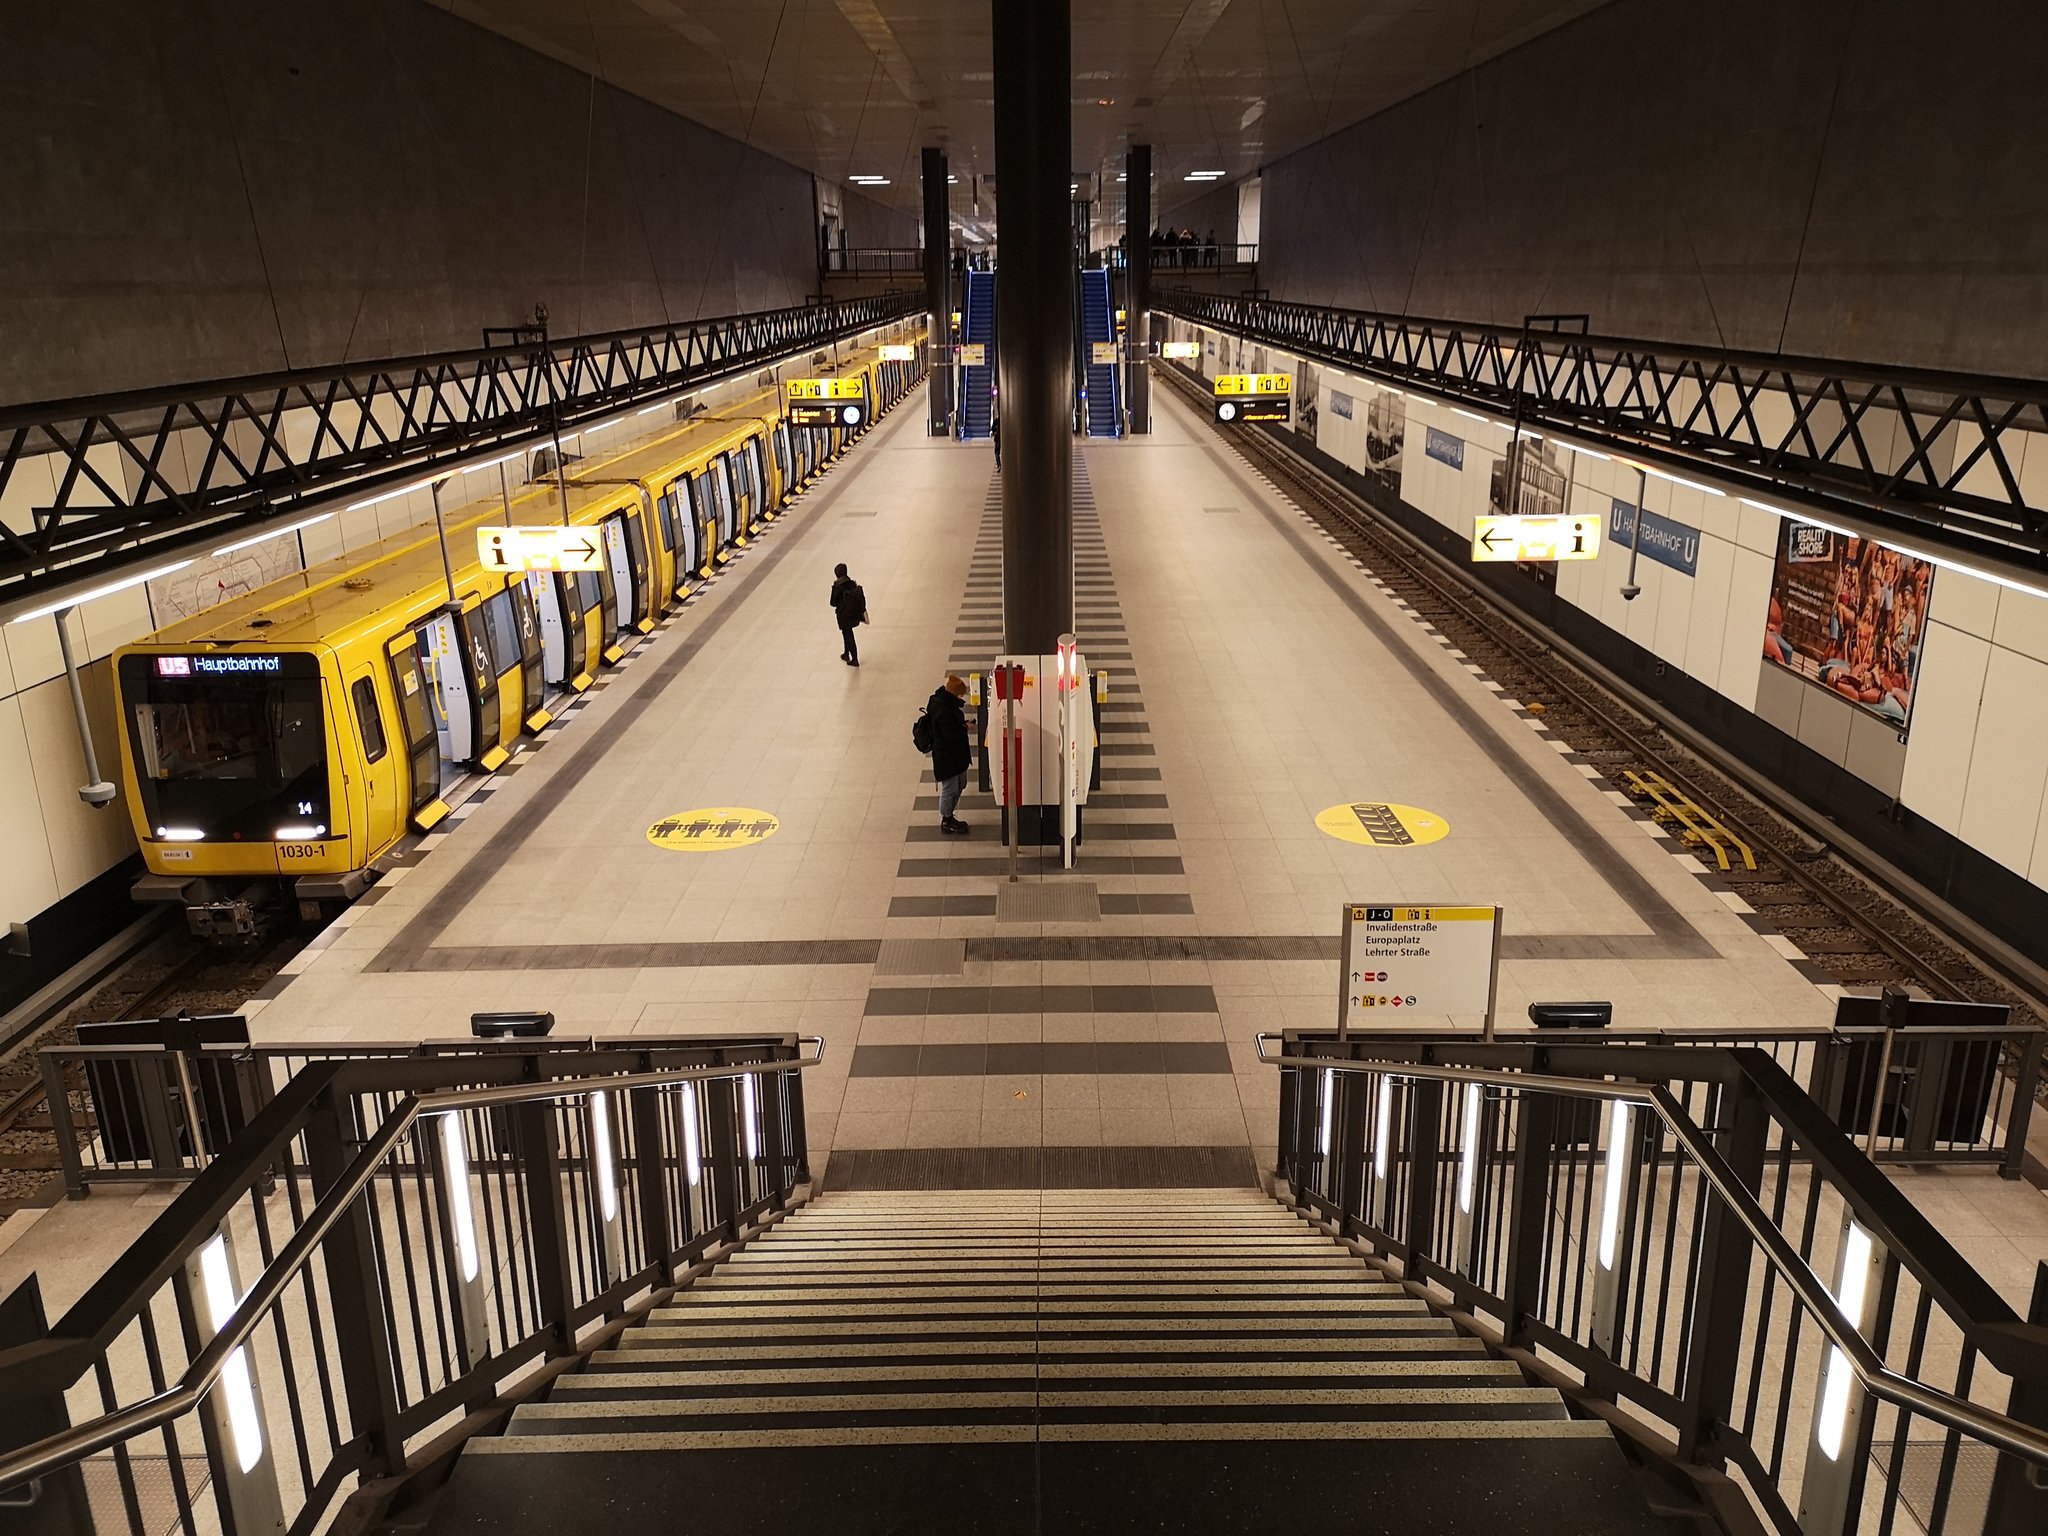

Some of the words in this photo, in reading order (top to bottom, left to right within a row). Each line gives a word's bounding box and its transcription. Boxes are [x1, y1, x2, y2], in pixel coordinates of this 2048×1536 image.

[1613, 508, 1622, 532] U
[1684, 537, 1695, 563] U
[1797, 528, 1827, 543] REALITY
[1798, 541, 1824, 555] SHORE
[161, 657, 189, 675] U5
[194, 657, 280, 674] Hauptbahnhof
[298, 801, 313, 815] 14
[279, 844, 326, 859] 1030-1
[1366, 922, 1438, 932] Invalidenstraße
[1365, 935, 1421, 946] Europaplatz
[1365, 948, 1398, 957] Lehrter
[1400, 947, 1431, 957] Straße
